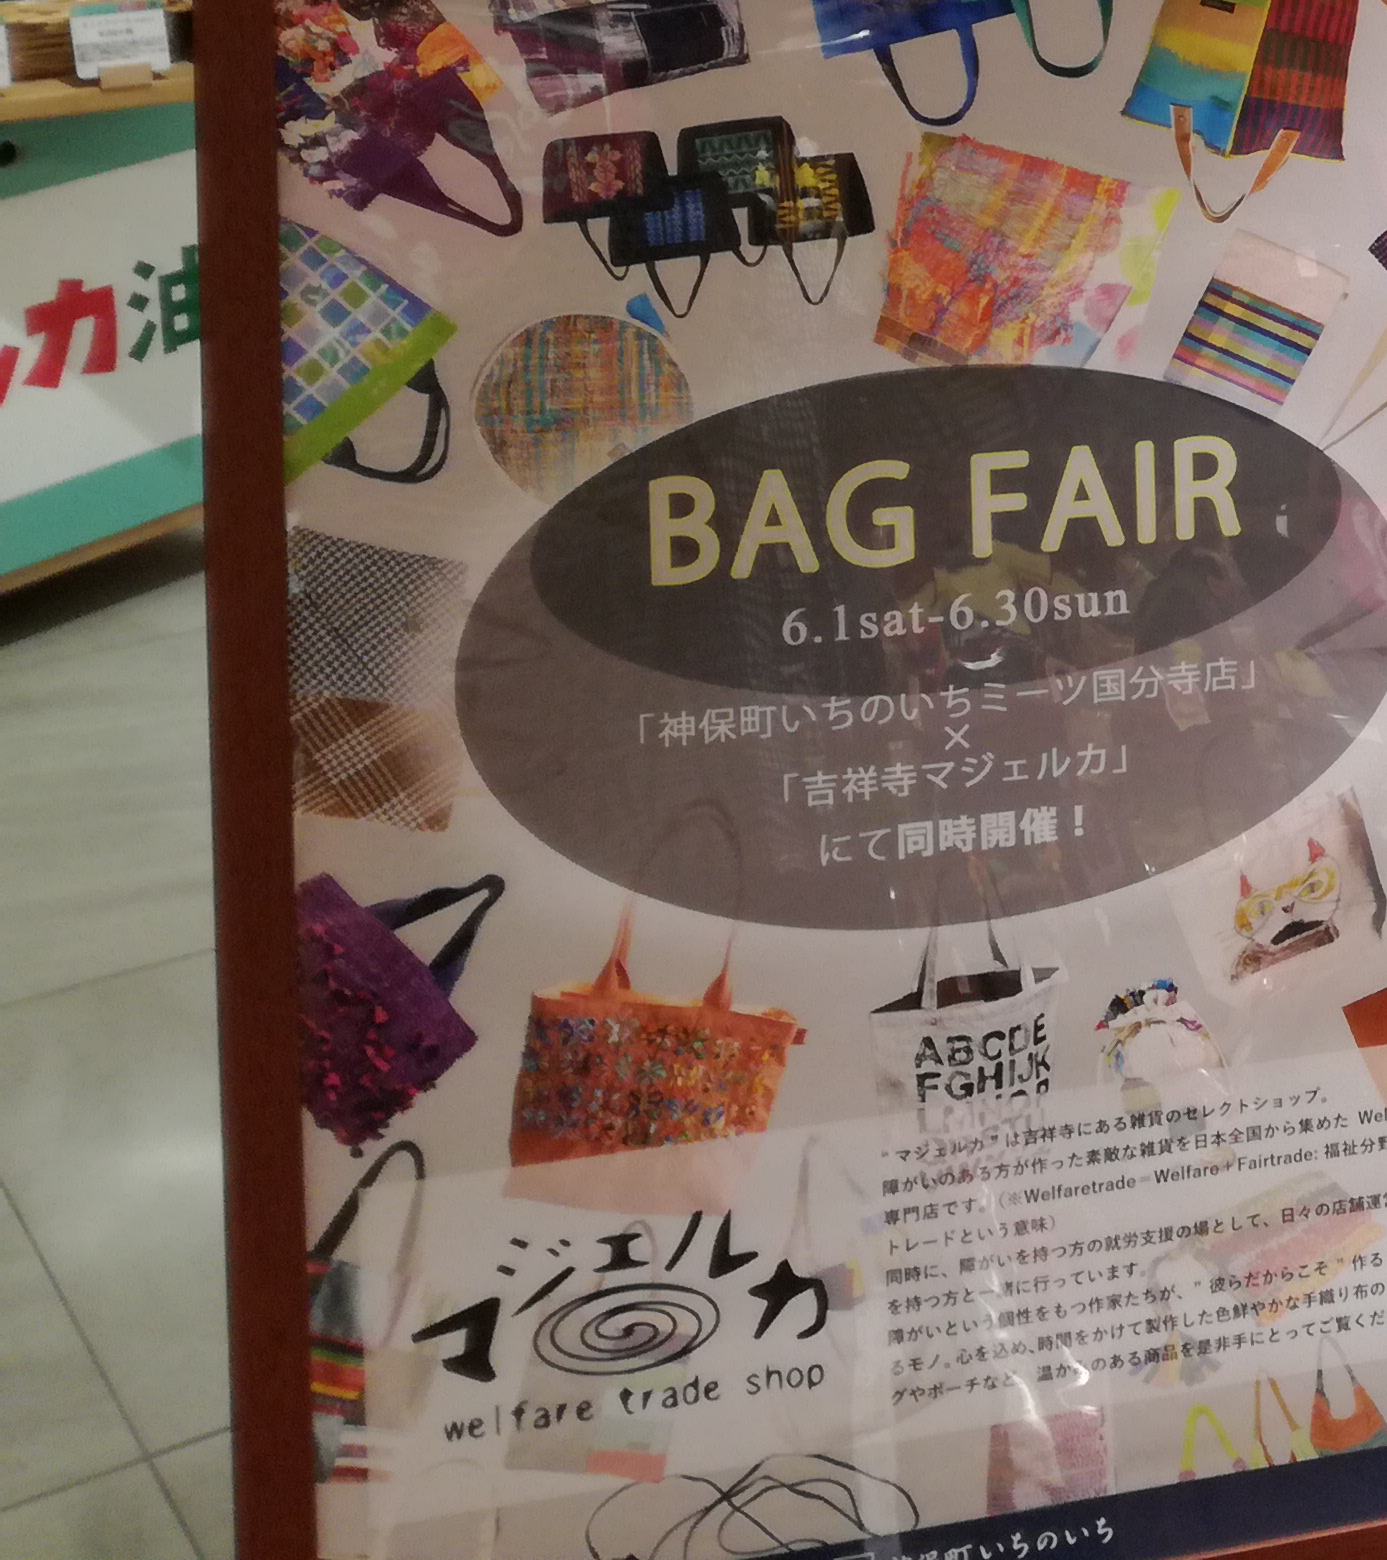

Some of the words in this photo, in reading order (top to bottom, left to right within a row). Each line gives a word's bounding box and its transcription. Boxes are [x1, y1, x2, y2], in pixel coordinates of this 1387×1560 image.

[647, 456, 917, 587] BAG
[970, 434, 1241, 560] FAIR
[780, 582, 1131, 648] 6.1sat-6.30sun
[639, 656, 1260, 749] 「神保町いちのいちミーツ国分寺店」
[780, 739, 1131, 807] 「吉祥寺マジェルカ」
[411, 1209, 829, 1383] マジェルカ
[444, 1395, 594, 1443] welfare
[620, 1375, 721, 1415] trade
[745, 1362, 826, 1397] shop
